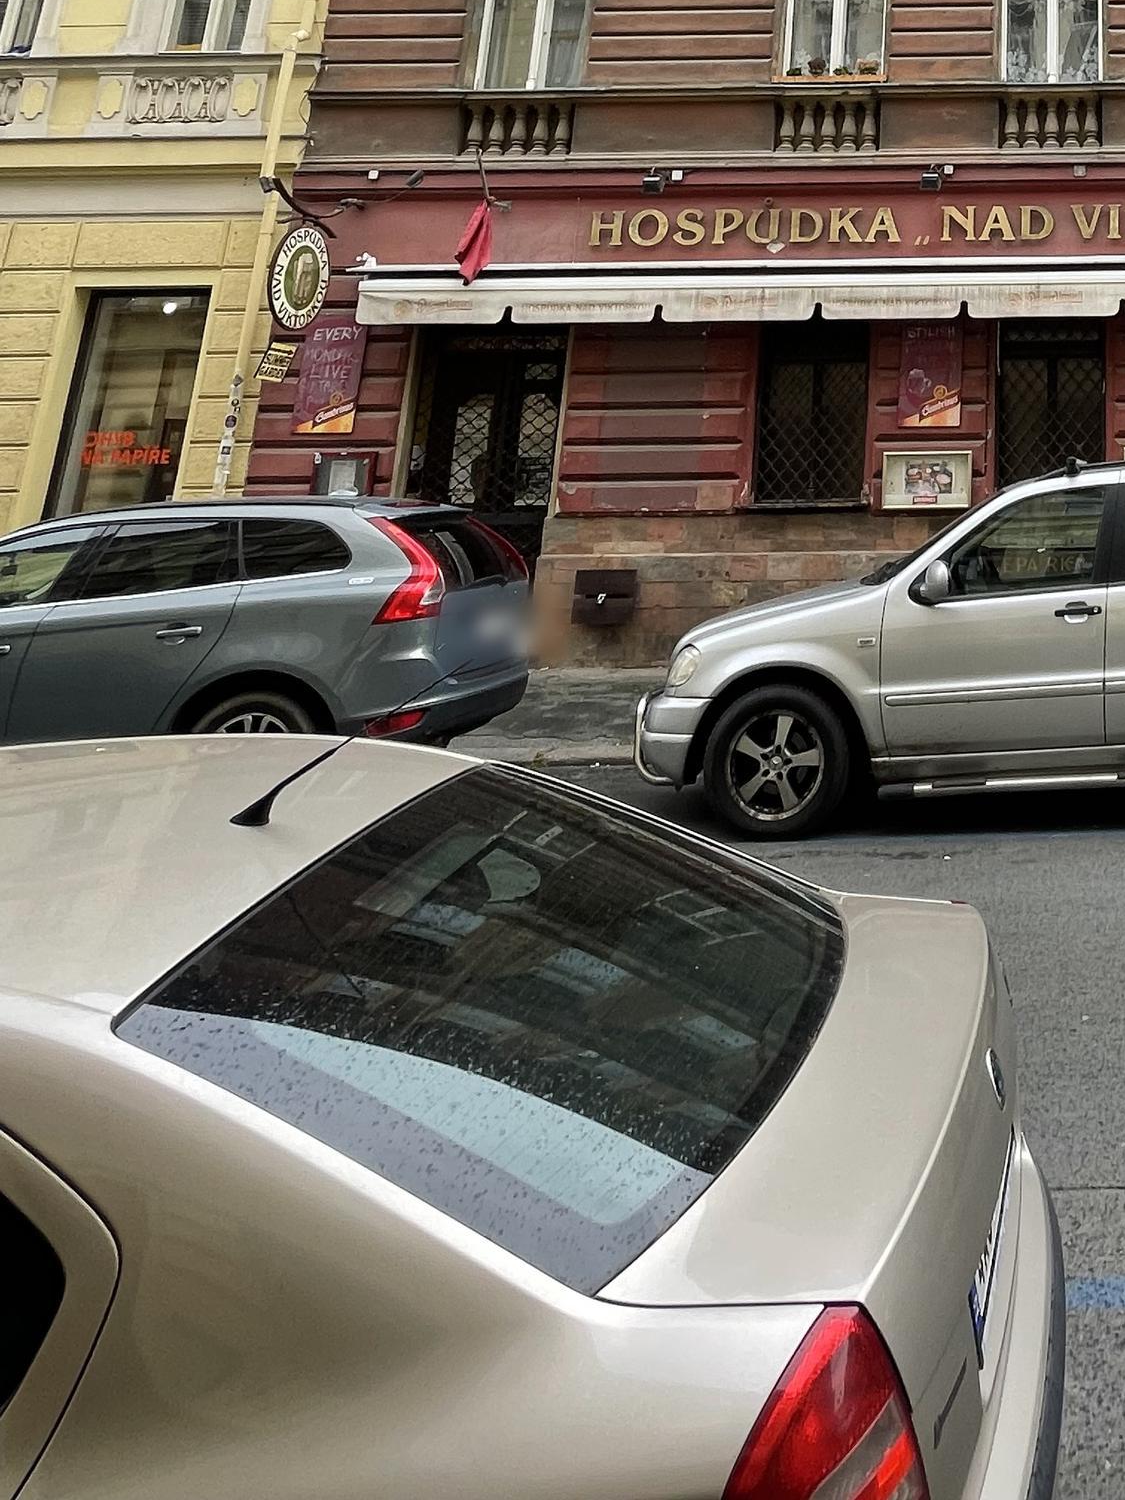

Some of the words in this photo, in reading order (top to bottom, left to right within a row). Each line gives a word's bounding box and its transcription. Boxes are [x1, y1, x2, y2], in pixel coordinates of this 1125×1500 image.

[277, 279, 329, 328] VIKTORKOU
[313, 325, 363, 342] EVERY
[308, 364, 352, 381] LIVE
